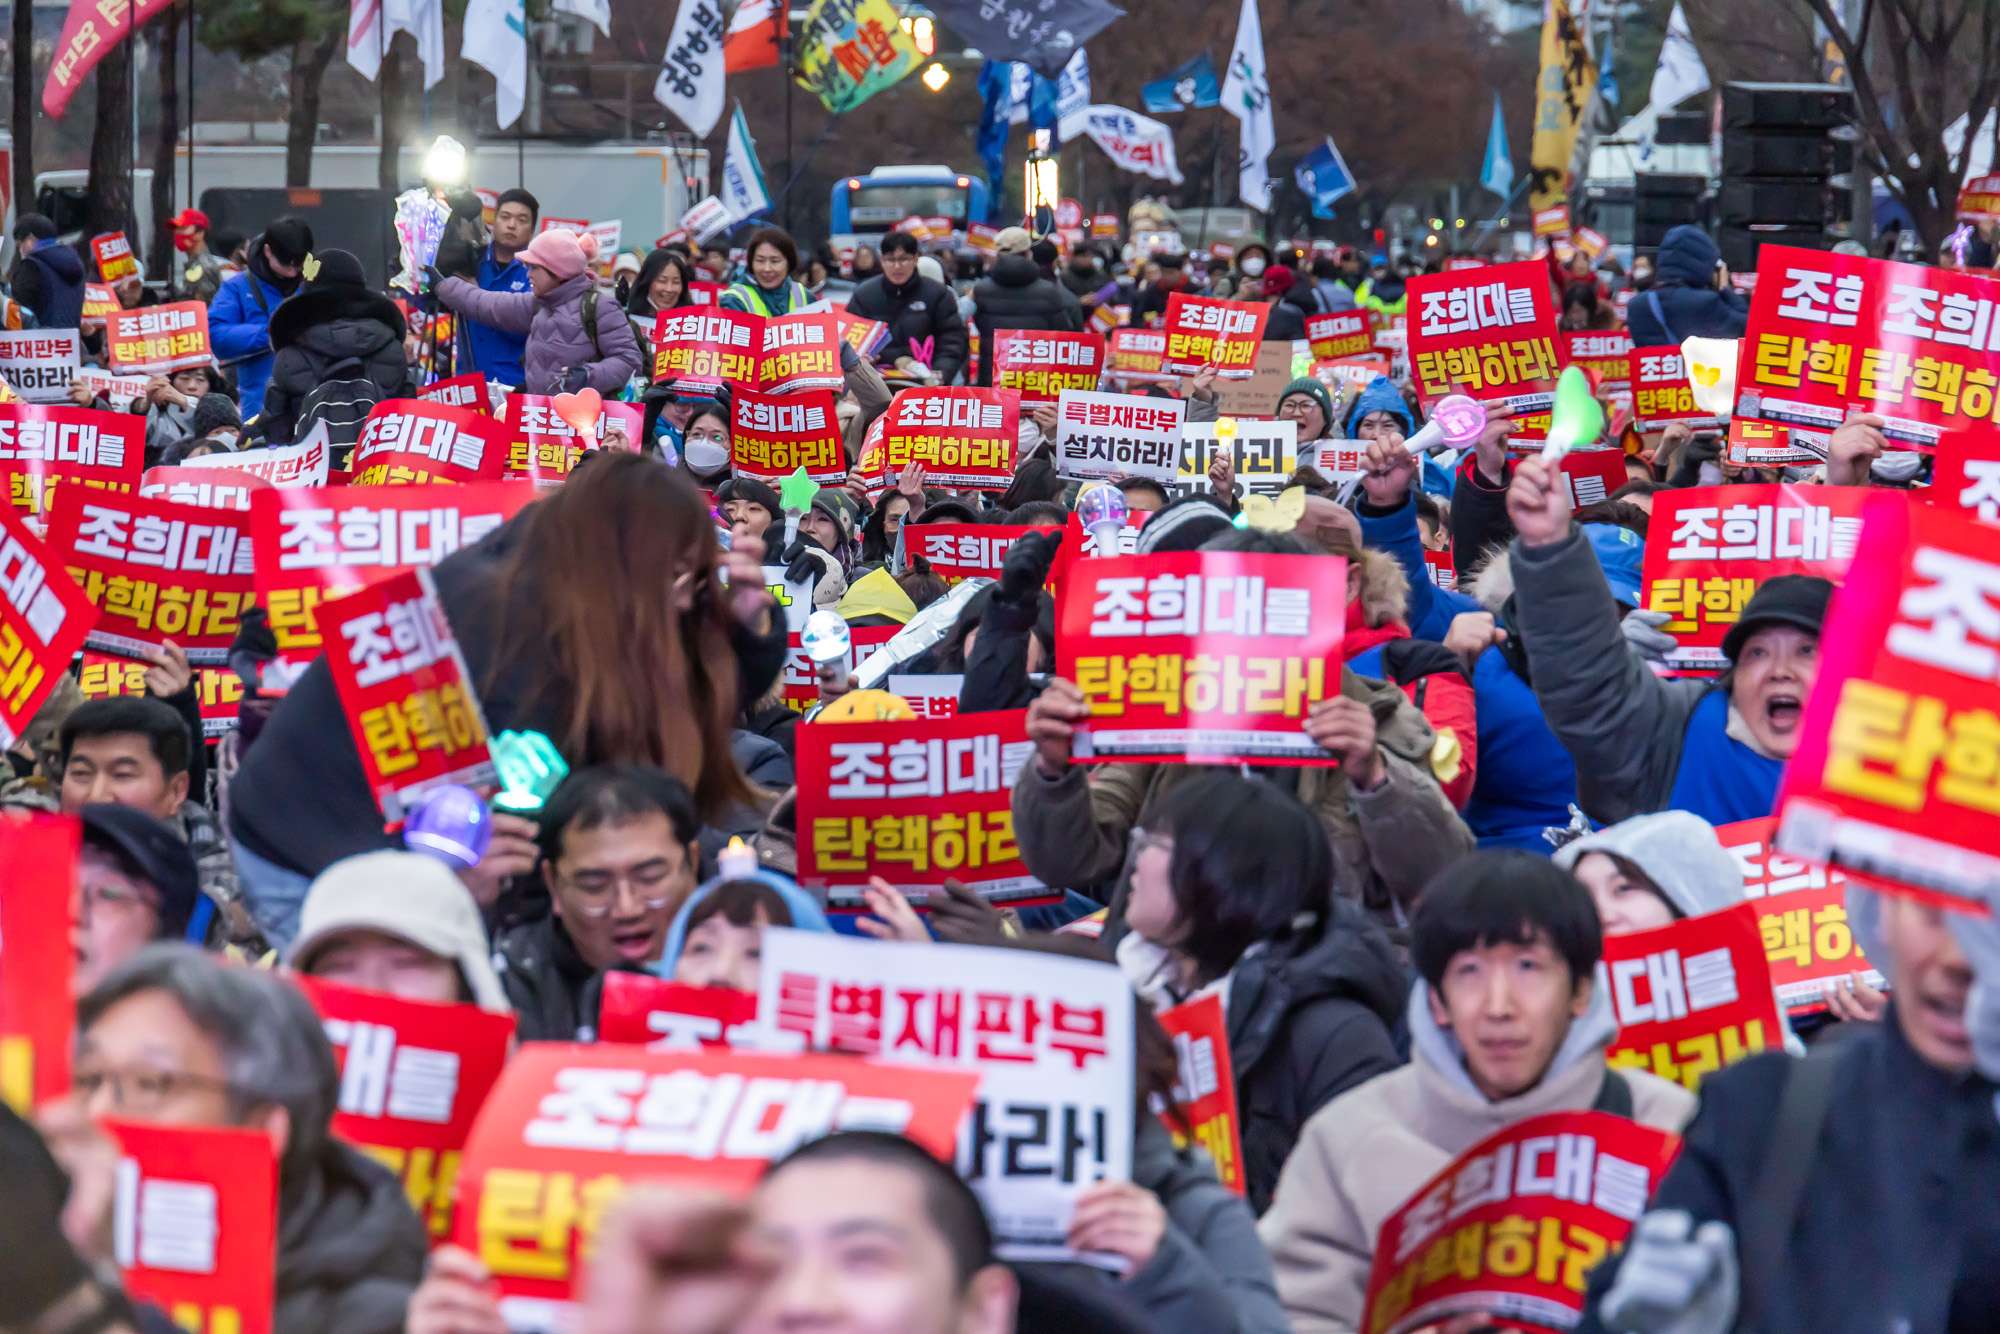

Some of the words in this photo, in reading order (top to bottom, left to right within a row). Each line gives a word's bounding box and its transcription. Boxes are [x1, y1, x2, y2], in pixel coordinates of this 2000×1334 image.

[119, 311, 197, 337] 조희대를
[1180, 303, 1258, 335] 조희대를
[1421, 282, 1536, 337] 조희대를
[1882, 284, 2000, 352] 조희
[115, 331, 204, 362] 탄핵하라!
[662, 315, 751, 347] 조희대를
[0, 339, 73, 359] 별재판부
[1007, 338, 1095, 366] 조희대를
[1168, 333, 1255, 364] 탄핵하라!
[0, 366, 73, 390] 치하라!
[655, 349, 755, 383] 탄핵하라!
[1416, 337, 1561, 396] 탄핵하라!
[1640, 355, 1690, 382] 조희
[738, 398, 826, 430] 조희대를
[897, 397, 1003, 429] 조희대를
[1065, 401, 1178, 433] 특별재판부
[358, 412, 485, 471] 조희대를
[734, 434, 838, 470] 탄핵하라!
[889, 436, 1010, 469] 탄핵하라!
[1063, 434, 1174, 468] 설치하라!
[74, 504, 255, 576] 조희대를
[1668, 504, 1864, 562] 조희대를
[1090, 572, 1311, 638] 조희대를
[1074, 653, 1325, 718] 탄핵하라!
[828, 735, 1036, 799] 조희대를
[775, 970, 1110, 1068] 특별재판부
